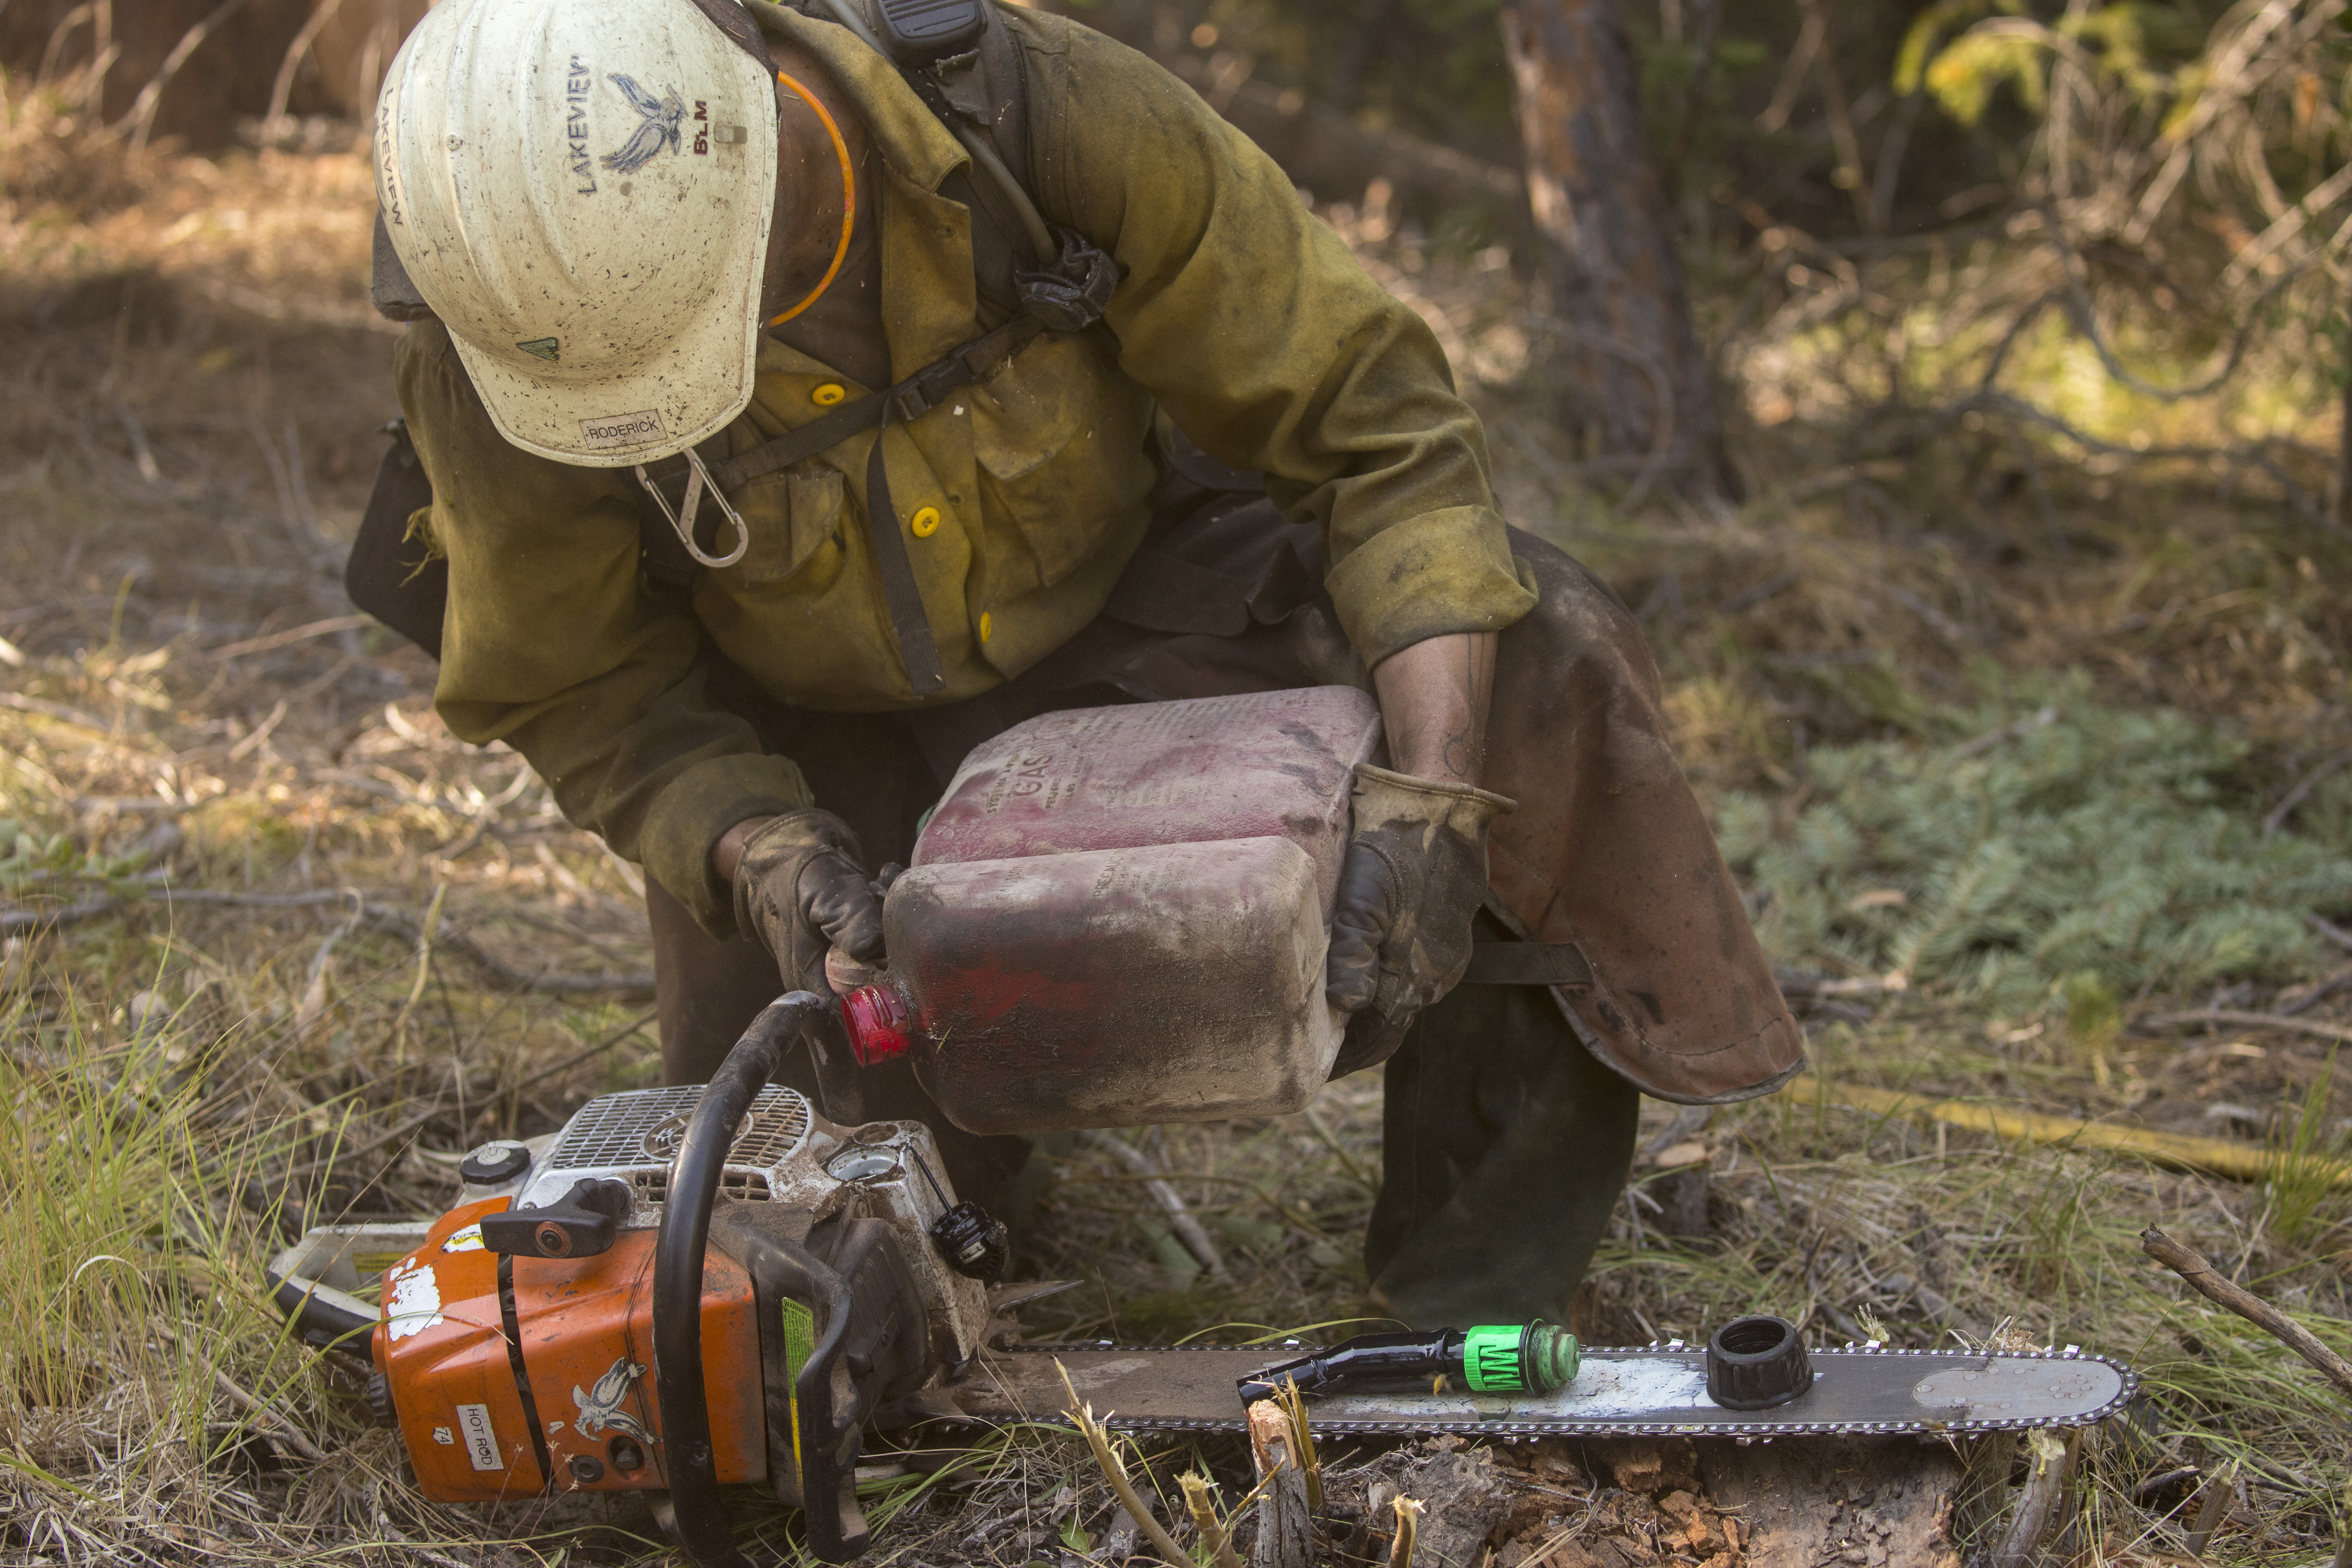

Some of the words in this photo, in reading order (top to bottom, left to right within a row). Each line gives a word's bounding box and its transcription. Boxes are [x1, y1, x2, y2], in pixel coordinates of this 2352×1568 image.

[567, 55, 597, 194] LAKEVIEW
[694, 100, 707, 155] BLM
[589, 420, 659, 439] RODERICK
[784, 1300, 811, 1318] WARNING!
[467, 1409, 484, 1434] HOT
[437, 1429, 450, 1443] 74
[475, 1438, 492, 1465] ROD
